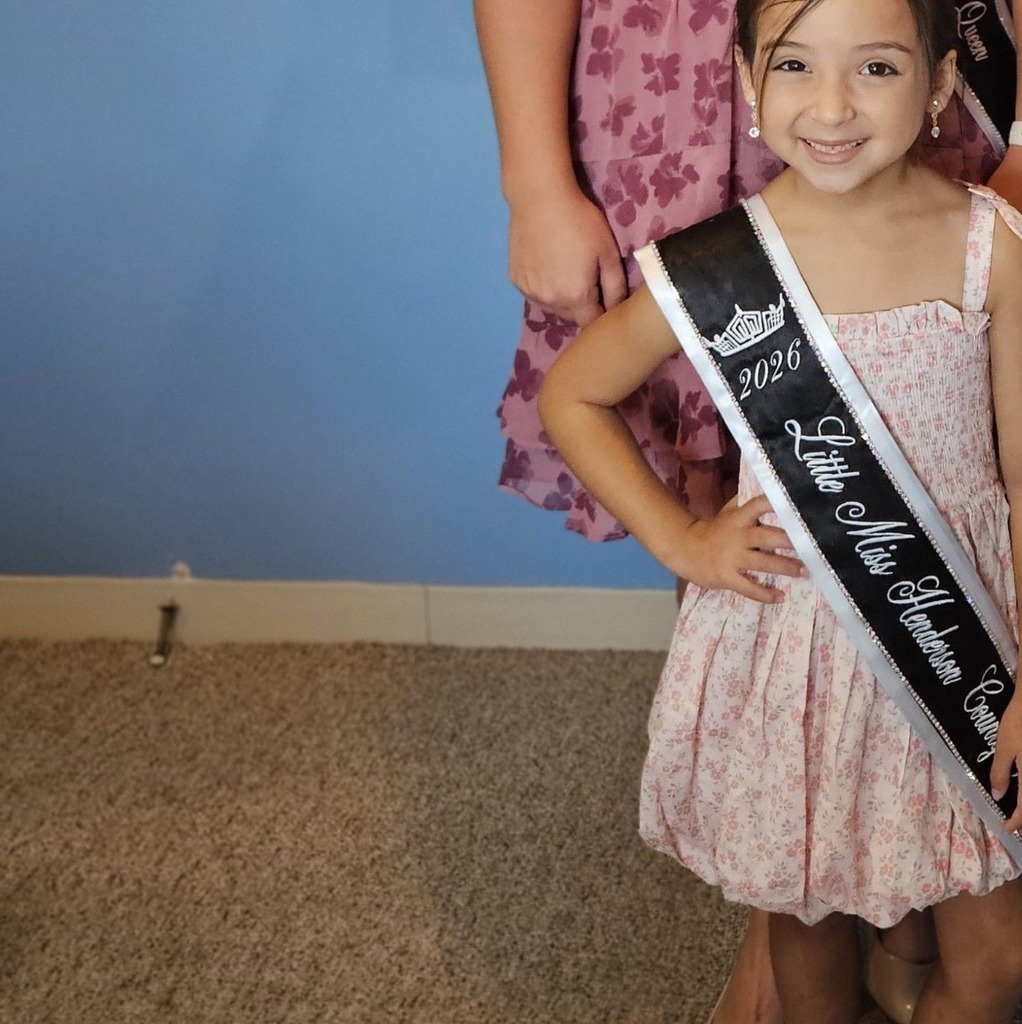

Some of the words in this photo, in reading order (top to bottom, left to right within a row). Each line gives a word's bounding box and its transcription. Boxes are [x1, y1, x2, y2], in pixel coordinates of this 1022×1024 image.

[954, 0, 990, 62] Queen
[739, 338, 802, 401] 2026
[784, 415, 860, 493] Little
[835, 501, 916, 575] Miss
[887, 575, 962, 686] Henderson
